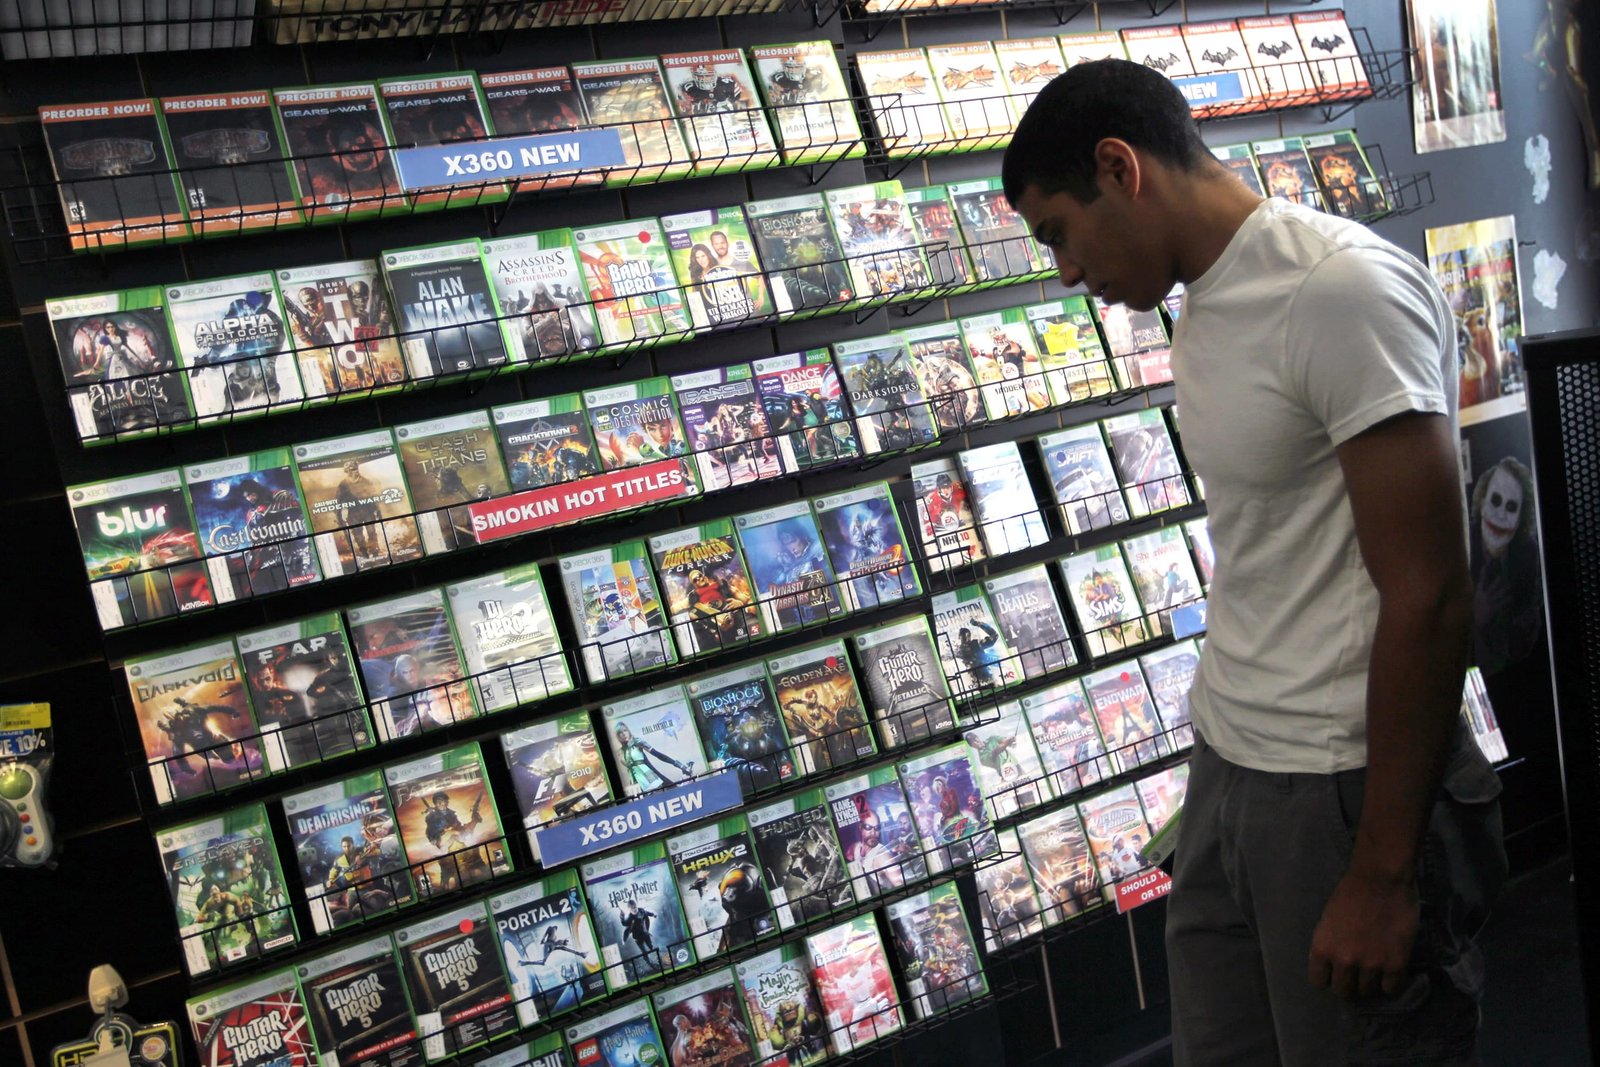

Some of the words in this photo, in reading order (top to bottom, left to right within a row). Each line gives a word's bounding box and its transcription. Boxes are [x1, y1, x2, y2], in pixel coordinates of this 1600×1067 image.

[663, 55, 709, 66] PREORDER
[712, 53, 739, 63] NOW!
[755, 46, 797, 57] PREORDER
[482, 72, 534, 85] PREORDER
[537, 69, 567, 80] NOW!
[577, 64, 626, 76] PREORDER
[630, 61, 658, 72] NOW!
[279, 90, 337, 103] PREORDER
[341, 87, 375, 98] NOW!
[383, 81, 437, 94] PREORDER
[441, 78, 473, 89] NOW!
[487, 88, 529, 99] GEARS
[537, 84, 561, 94] WAR
[1178, 82, 1218, 99] NEW
[42, 106, 109, 120] PREORDER
[113, 103, 151, 115] NOW!
[164, 98, 227, 111] PREORDER
[231, 95, 266, 106] NOW!
[284, 107, 329, 118] GEARS
[339, 104, 367, 112] WAR
[388, 98, 431, 109] GEARS
[440, 94, 466, 103] WAR
[442, 150, 513, 177] X360
[519, 142, 581, 168] NEW
[505, 269, 567, 286] BROTHERHOOD
[513, 263, 554, 277] CREED
[608, 259, 652, 283] BAND
[418, 277, 465, 300] ALAN
[612, 275, 657, 298] HERO
[403, 292, 490, 331] WAKE
[195, 313, 273, 336] ALPHA
[195, 324, 278, 344] PROTOCOL
[806, 353, 826, 361] KINECT
[728, 368, 748, 377] KINECT
[781, 368, 821, 385] DANCE
[852, 382, 919, 401] DARKSIDERS
[611, 398, 669, 417] COSMIC
[613, 406, 672, 429] DESTRUCTION
[416, 432, 478, 452] CLASH
[508, 426, 570, 445] CRACKDOWN
[417, 448, 487, 474] TITANS
[312, 501, 356, 515] MODERN
[358, 491, 404, 505] WARFARE
[473, 500, 559, 532] SMOKIN
[564, 487, 606, 511] HOT
[611, 470, 682, 498] TITLES
[97, 503, 168, 537] blur
[207, 516, 308, 551] Castlevania
[942, 535, 959, 546] NHL
[960, 532, 969, 541] 10
[662, 546, 694, 570] DUKE
[694, 539, 735, 561] NUKEM
[667, 553, 732, 575] FOREVER
[768, 580, 804, 597] DYNASTY
[997, 591, 1040, 614] BEATLES
[1089, 598, 1122, 620] SIMS
[879, 650, 922, 674] GUITAR
[888, 664, 923, 689] HERO
[703, 686, 761, 712] BIOSHOCK
[1095, 684, 1144, 710] ENDWAR
[732, 705, 739, 716] 2
[570, 766, 592, 779] 2010
[578, 811, 643, 846] X360
[647, 790, 704, 825] NEW
[834, 808, 858, 821] LYNCH
[172, 837, 264, 871] ENSLAVED
[608, 886, 632, 908] Harry
[632, 879, 659, 903] Potter
[1120, 874, 1157, 895] SHOULD
[1141, 890, 1154, 901] OR
[497, 903, 559, 935] PORTAL
[559, 898, 572, 914] 2
[424, 937, 482, 974] GUITAR
[436, 956, 479, 989] HERO
[325, 973, 386, 1010] GUITAR
[457, 976, 471, 991] 5
[336, 991, 383, 1027] HERO
[222, 1009, 288, 1049] GUITAR
[360, 1013, 372, 1029] 5
[233, 1031, 285, 1066] HERO
[579, 1045, 597, 1060] LEGO
